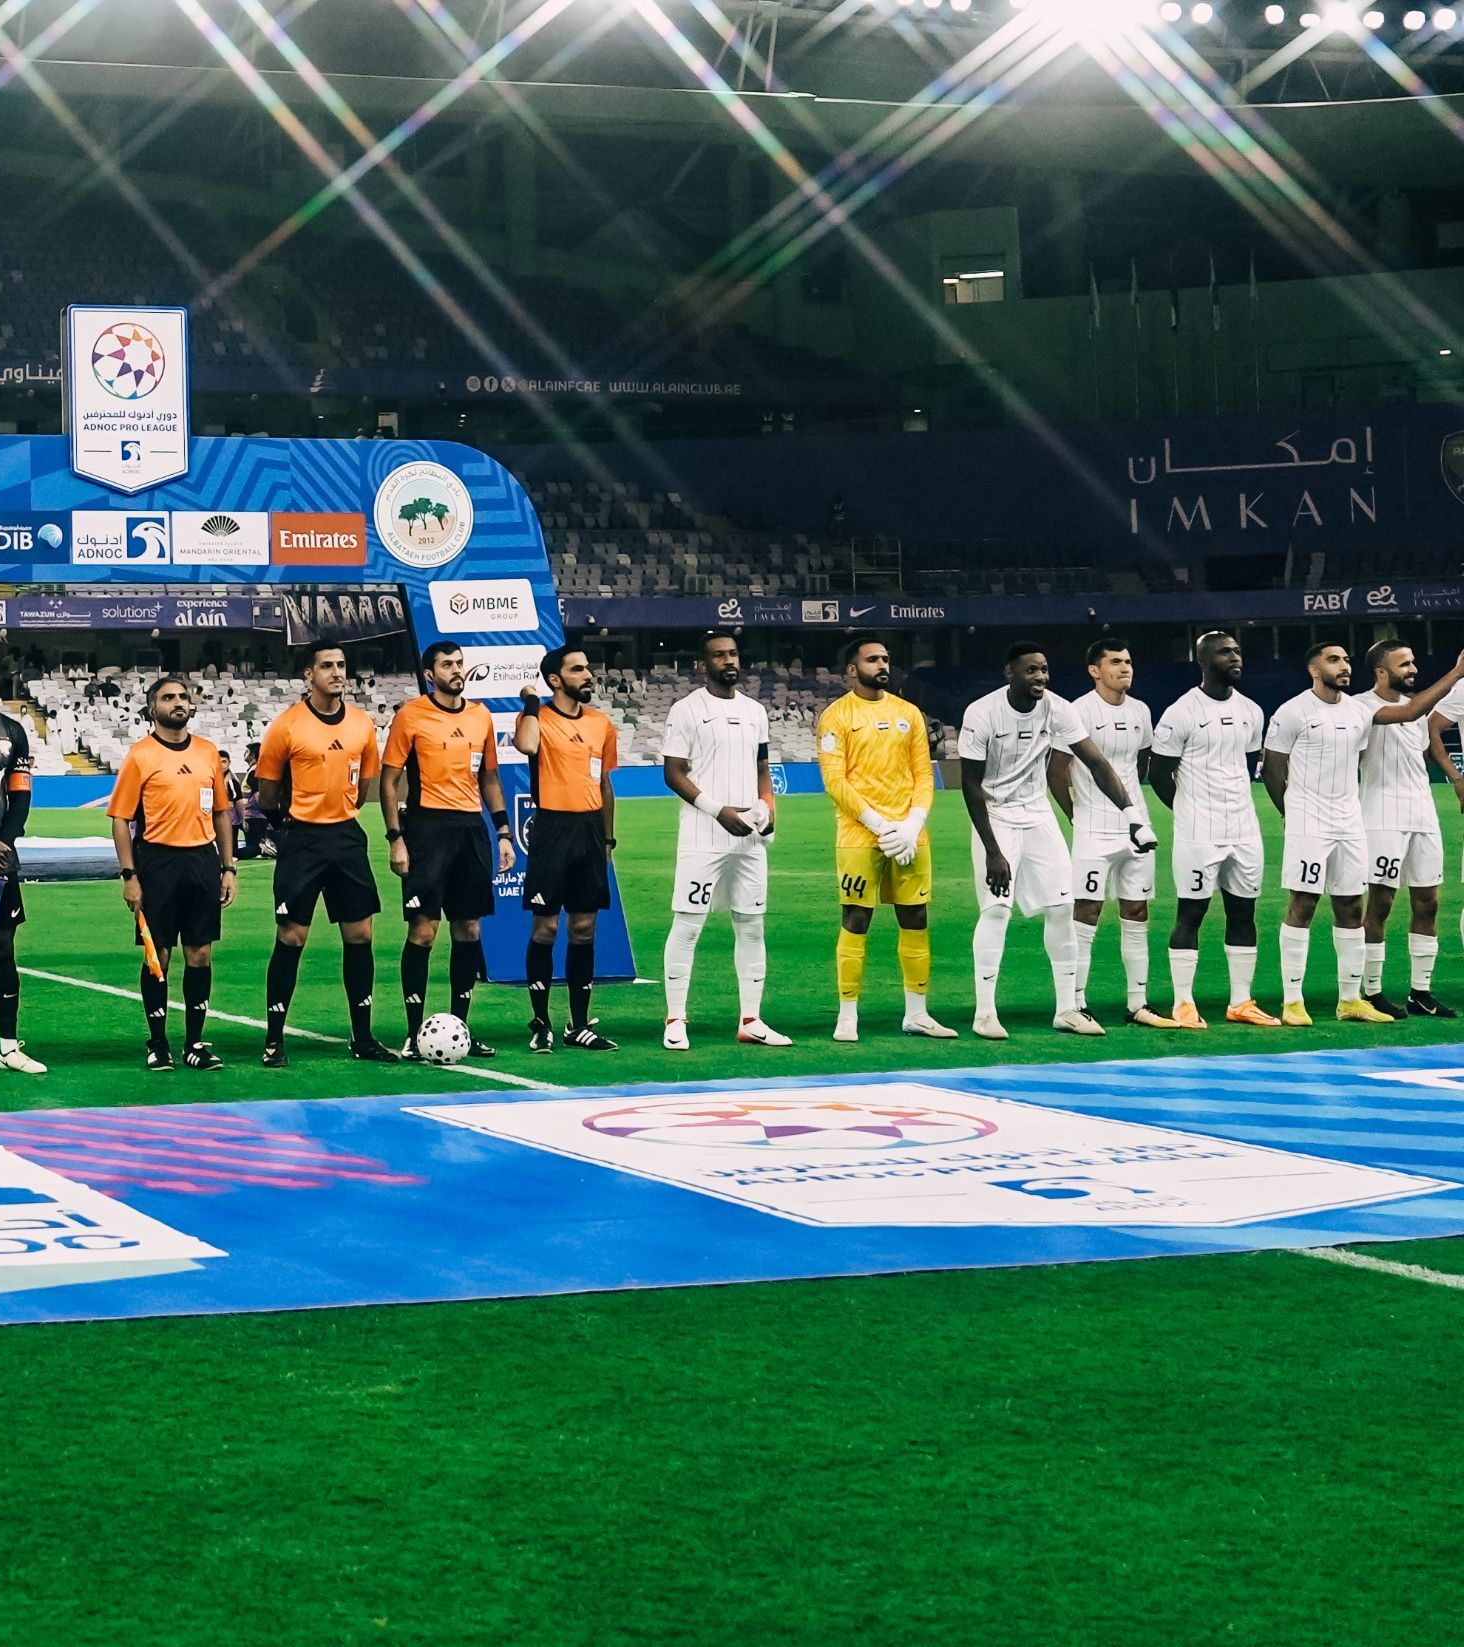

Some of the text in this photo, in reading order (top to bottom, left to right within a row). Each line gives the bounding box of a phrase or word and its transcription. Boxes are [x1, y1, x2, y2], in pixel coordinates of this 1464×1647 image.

[141, 424, 177, 432] LEAGUE
[1130, 486, 1377, 534] IMKAN
[280, 530, 358, 549] Emirates
[77, 548, 123, 559] ADNOC
[223, 548, 262, 556] ORIENTAL
[176, 599, 228, 608] experience
[472, 597, 519, 610] MBME
[1304, 594, 1341, 611] FAB
[890, 605, 945, 619] Emirates
[493, 672, 521, 681] Etihad
[1300, 859, 1321, 884] 19
[1374, 856, 1401, 880] 96
[841, 873, 866, 899] 44
[1085, 870, 1100, 893] 6
[1191, 869, 1204, 892] 3
[498, 887, 518, 897] UAE
[688, 880, 712, 905] 26
[735, 1169, 925, 1186] ADNOC
[930, 1163, 1037, 1176] PRO
